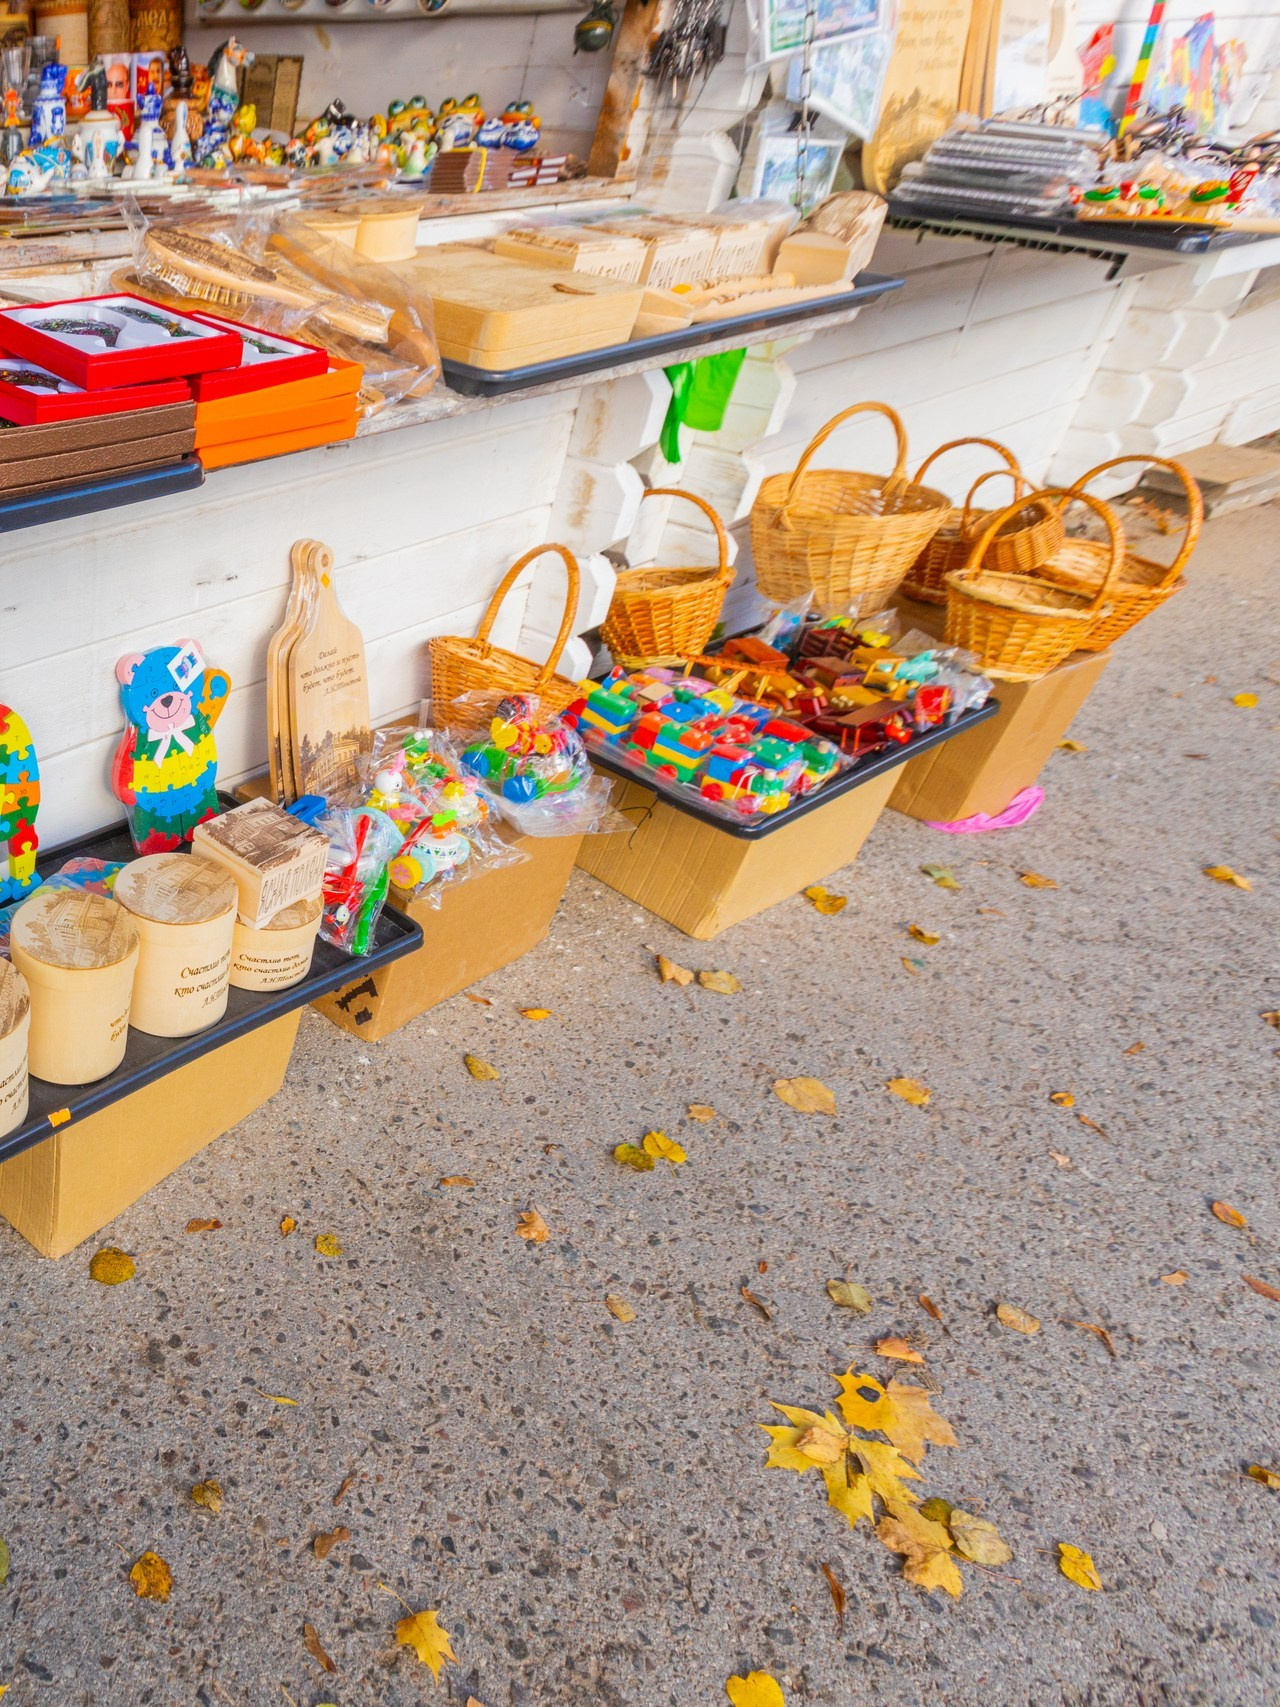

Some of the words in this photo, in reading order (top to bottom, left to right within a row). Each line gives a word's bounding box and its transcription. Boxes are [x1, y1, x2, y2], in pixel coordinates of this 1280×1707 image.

[258, 868, 292, 917] ЯСНАЯ
[239, 953, 281, 964] Счастлив
[180, 959, 220, 979] Счастлив
[174, 986, 195, 998] Кто
